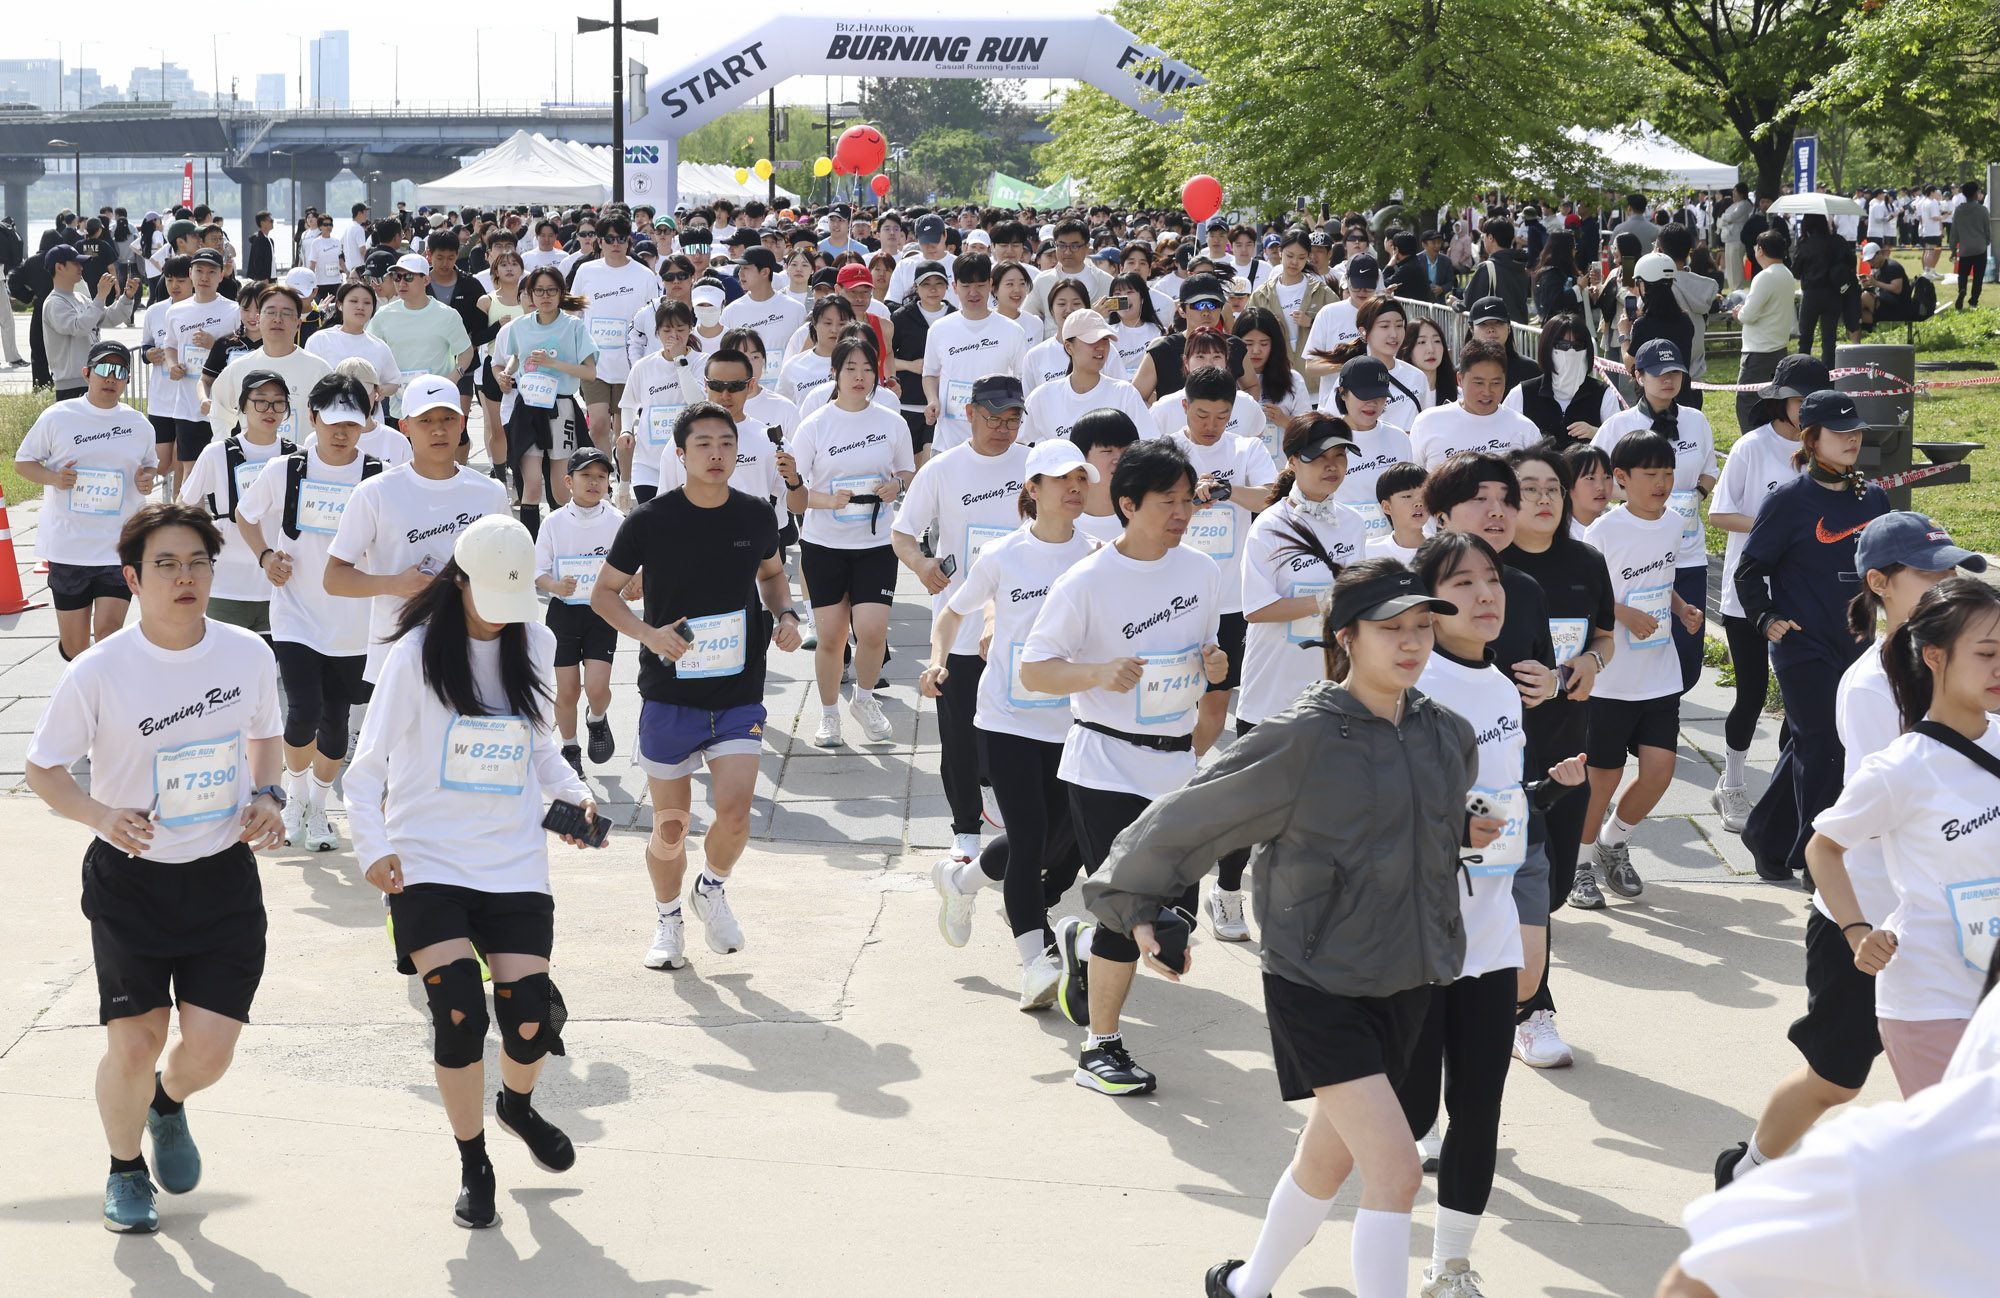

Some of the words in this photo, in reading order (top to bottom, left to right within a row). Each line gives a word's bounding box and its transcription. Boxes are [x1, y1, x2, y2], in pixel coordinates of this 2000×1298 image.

[826, 35, 971, 62] BURNING
[976, 37, 1048, 62] RUN
[935, 63, 965, 71] Casual
[967, 63, 1003, 72] Running
[661, 41, 767, 118] START
[619, 286, 634, 294] Run
[768, 314, 784, 322] Run
[180, 322, 206, 333] Burning
[601, 329, 622, 337] 7409
[1339, 332, 1361, 341] Burni
[948, 342, 981, 356] Burning
[981, 338, 999, 348] Run
[1044, 369, 1067, 381] Burni
[528, 383, 552, 394] 8156
[649, 382, 678, 395] Burning
[277, 424, 291, 432] 50
[661, 419, 675, 427] 85
[73, 430, 111, 445] Burning
[111, 426, 132, 437] Run
[563, 419, 575, 451] UFC
[828, 440, 866, 457] Burning
[866, 433, 887, 445] Run
[1488, 439, 1512, 451] Run
[1677, 441, 1697, 450] Run
[1376, 455, 1397, 466] Run
[87, 485, 118, 497] 7132
[962, 488, 1005, 506] Burning
[1005, 480, 1026, 495] Ru
[318, 501, 345, 514] 714
[1365, 518, 1387, 529] 065
[407, 522, 456, 544] Burning
[1191, 526, 1227, 537] 7280
[594, 547, 610, 556] Ru
[1334, 543, 1354, 556] Run
[1621, 559, 1664, 580] Burning
[573, 574, 597, 584] 704
[881, 588, 894, 597] BLAC
[1010, 585, 1050, 602] Burni
[1122, 608, 1171, 640] Burning
[1171, 595, 1199, 614] Run
[698, 635, 739, 653] 7405
[1555, 645, 1576, 659] 17
[1148, 682, 1159, 691] M
[1163, 672, 1200, 693] 7414
[138, 701, 206, 737] Burning
[206, 687, 242, 709] Run
[1476, 728, 1501, 745] ning
[162, 749, 197, 762] BURNING
[198, 748, 216, 756] RUN
[454, 743, 468, 754] W
[470, 743, 525, 760] 8258
[167, 778, 179, 790] M
[184, 765, 236, 791] 7390
[1941, 805, 2000, 842] Burnin
[1969, 922, 1984, 935] W
